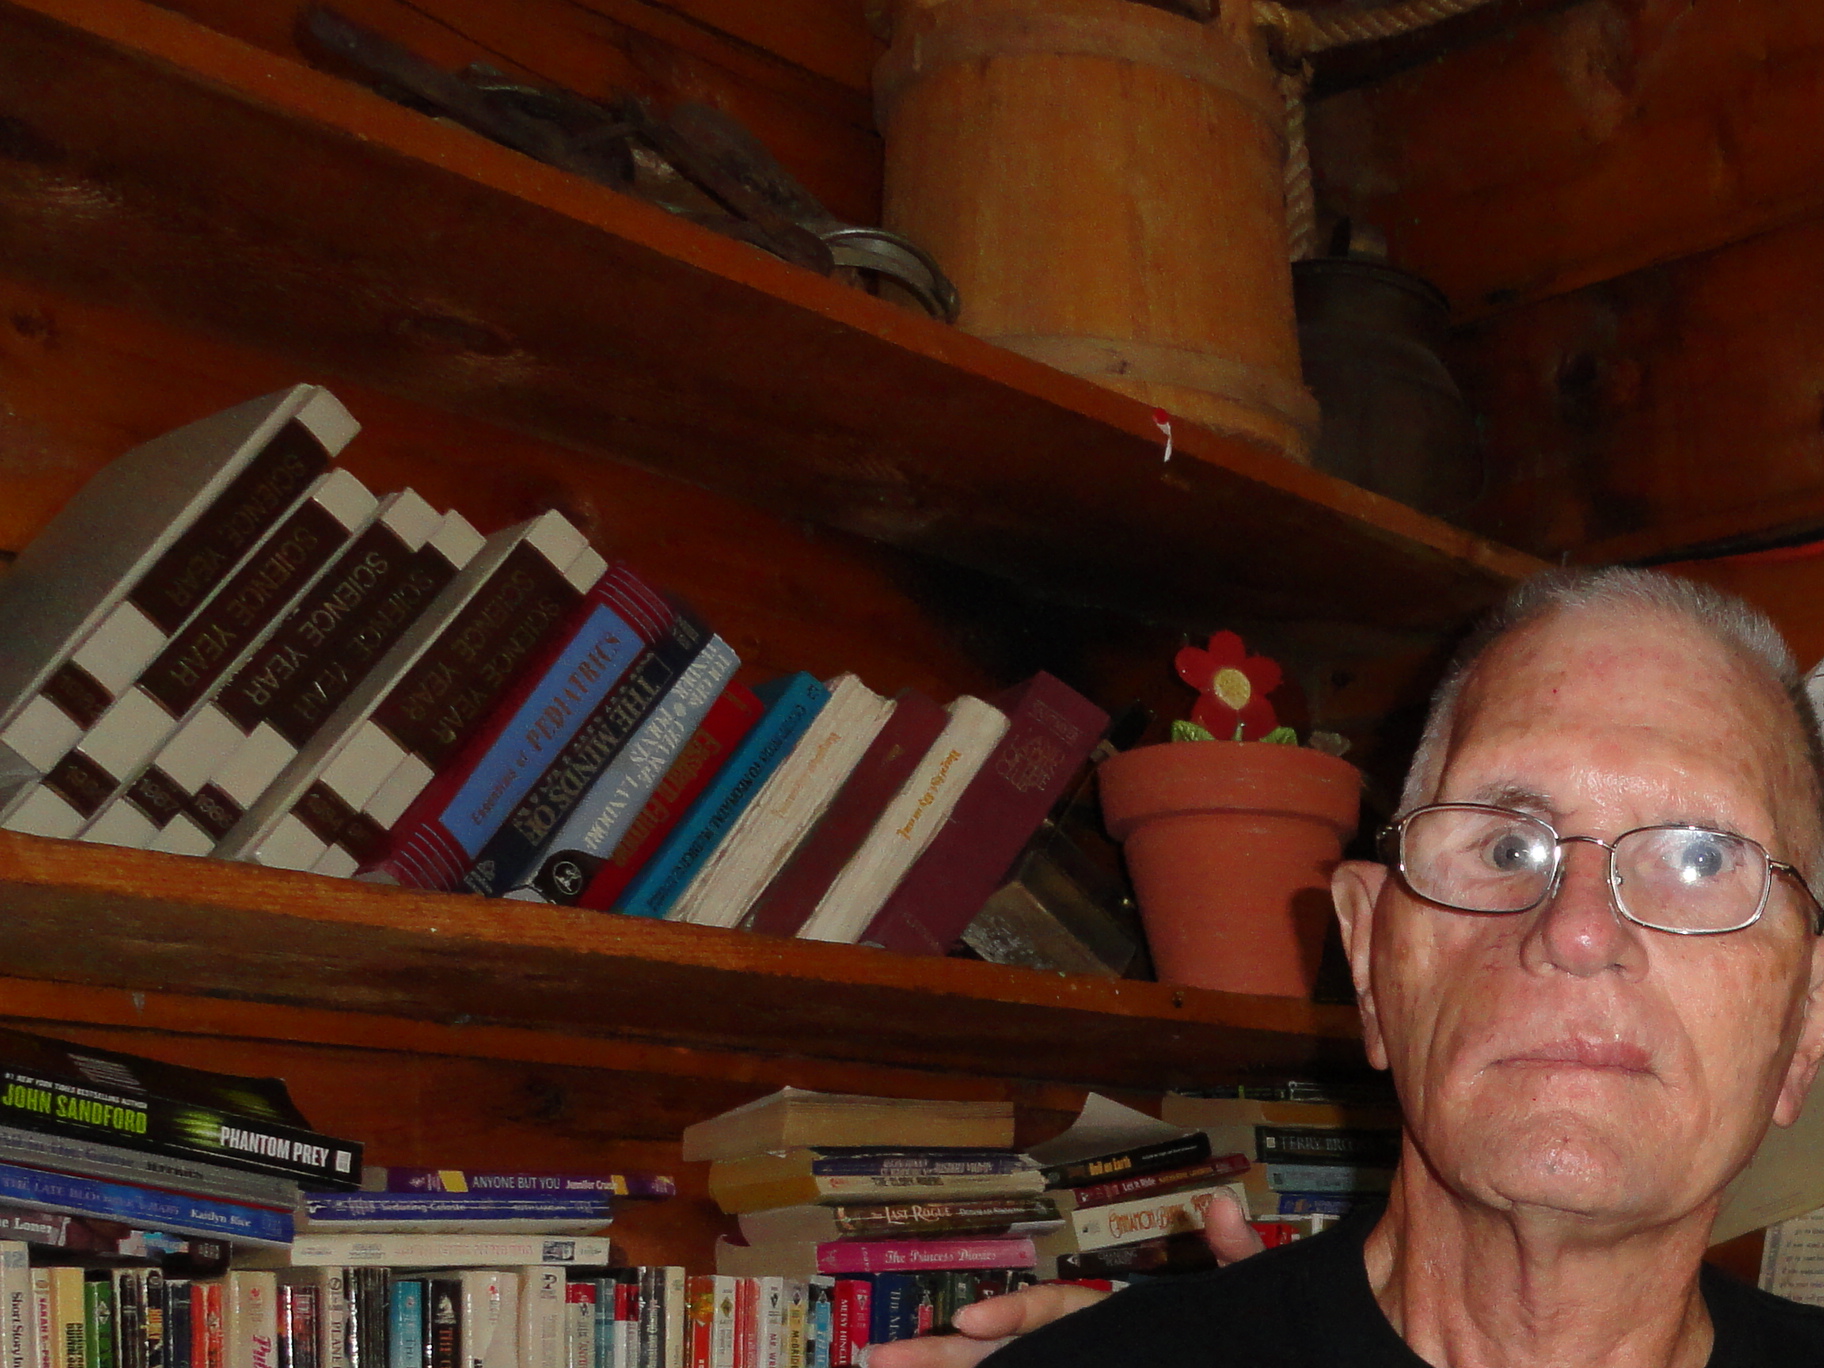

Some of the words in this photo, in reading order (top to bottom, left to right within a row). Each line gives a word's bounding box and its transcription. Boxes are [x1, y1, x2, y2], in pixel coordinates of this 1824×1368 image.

[224, 523, 321, 626] SCIENCE
[296, 547, 390, 647] SCIENCE
[449, 568, 539, 664] SCIENCE
[476, 592, 566, 689] SCIENCE
[167, 617, 238, 691] YEAR
[241, 639, 309, 710] YEAR
[397, 658, 460, 724] YEAR
[428, 680, 492, 747] YEAR
[524, 628, 625, 754] PEDIATRICS
[611, 675, 660, 735] THE
[547, 720, 622, 815] MINDS
[518, 800, 559, 845] OF
[3, 1084, 52, 1114] JOHN
[56, 1094, 148, 1134] SANDFORD
[220, 1126, 290, 1160] PHANTOM
[293, 1141, 330, 1168] PREY
[1279, 1136, 1320, 1150] TERRY
[473, 1176, 515, 1189] ANYONE
[518, 1176, 538, 1189] BUT
[539, 1176, 560, 1190] YOU
[14, 1219, 53, 1234] Loner
[885, 1251, 905, 1264] The
[910, 1251, 954, 1263] Princess
[958, 1250, 997, 1262] Diaries
[10, 1292, 24, 1324] Short
[840, 1299, 848, 1327] METSY
[890, 1289, 901, 1312] THE
[10, 1325, 24, 1355] Story
